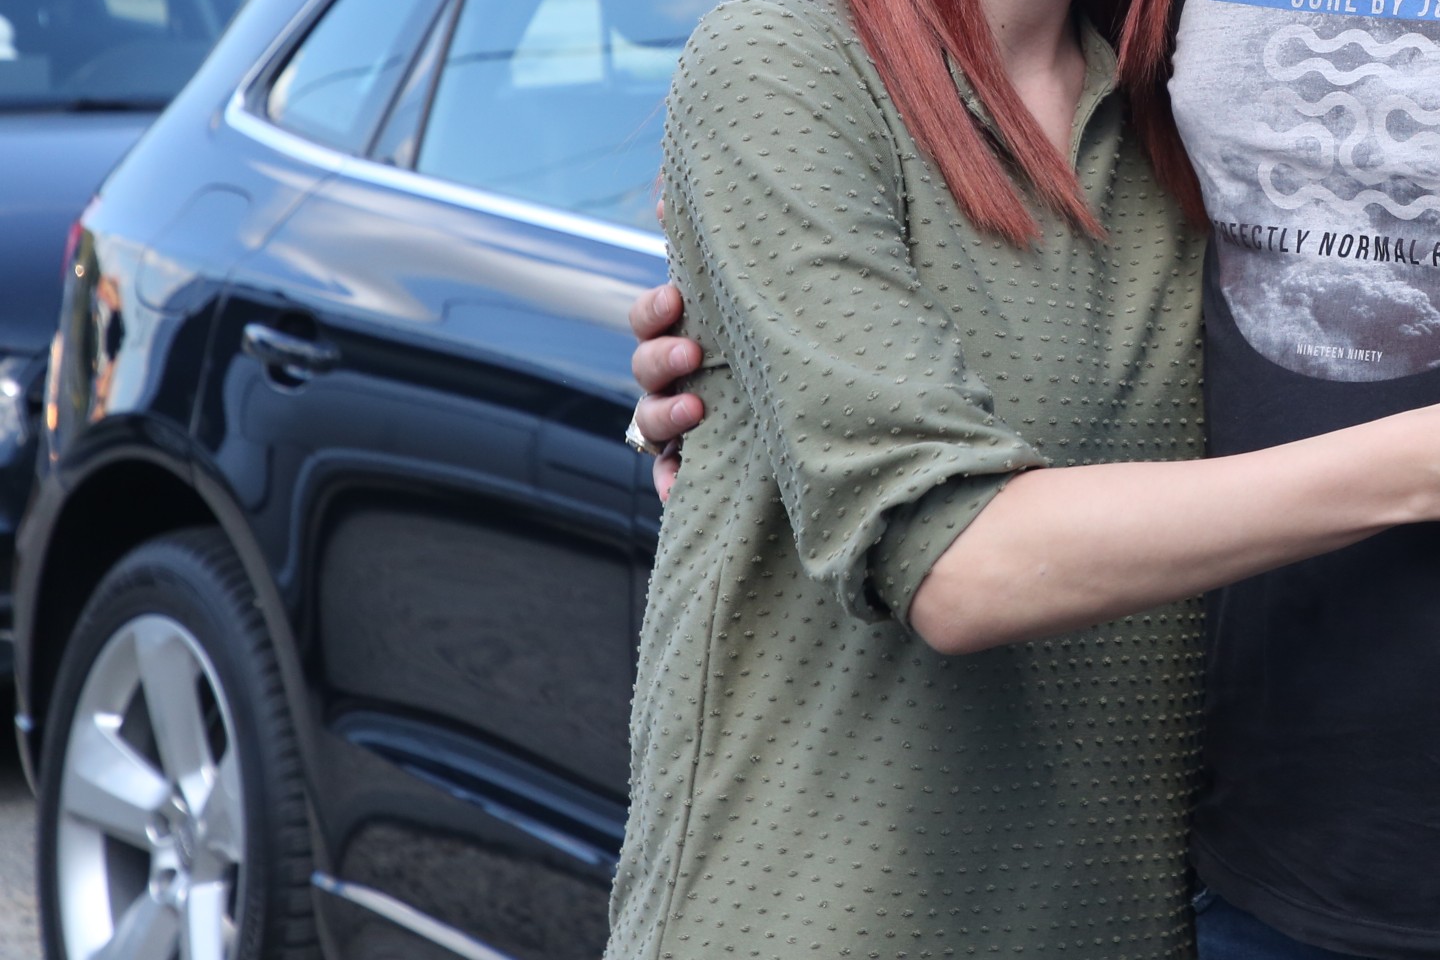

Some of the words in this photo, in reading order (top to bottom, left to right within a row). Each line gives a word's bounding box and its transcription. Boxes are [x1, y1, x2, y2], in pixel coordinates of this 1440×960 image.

[1318, 231, 1420, 266] NORMAL
[1296, 343, 1345, 359] NINETEEN
[1347, 348, 1383, 362] NINETY
